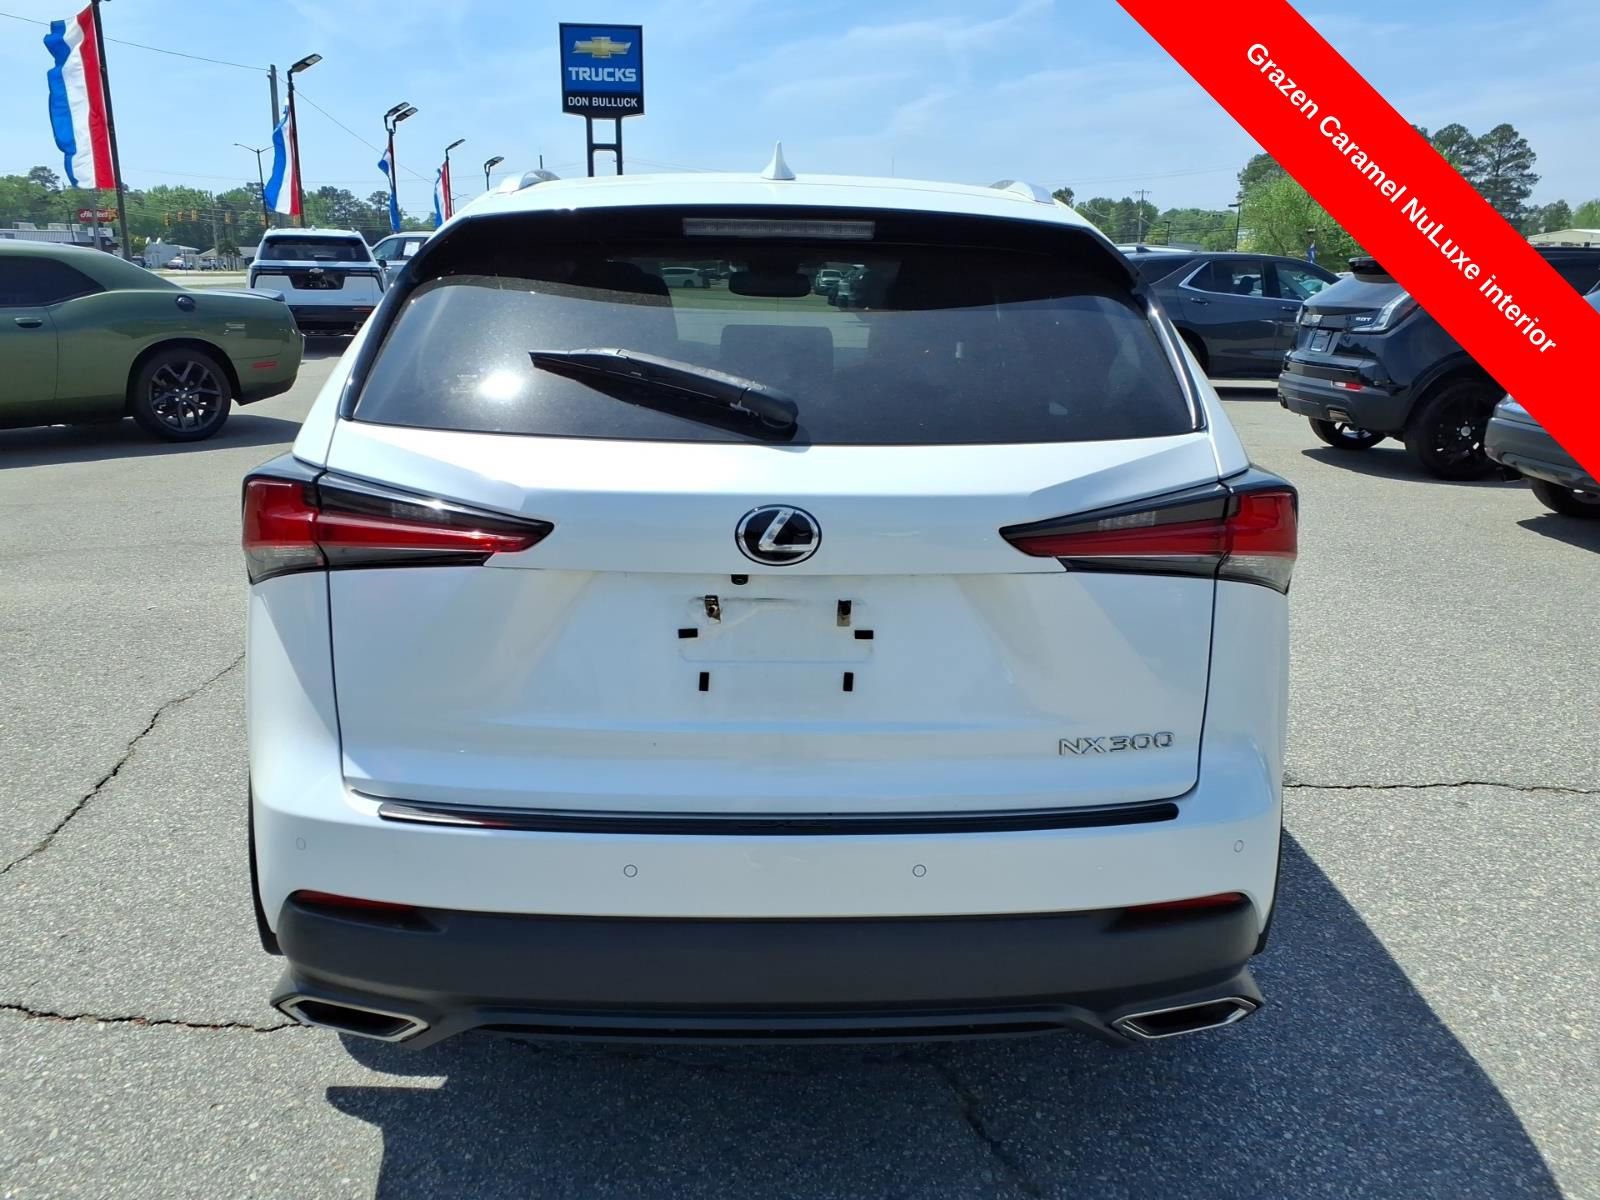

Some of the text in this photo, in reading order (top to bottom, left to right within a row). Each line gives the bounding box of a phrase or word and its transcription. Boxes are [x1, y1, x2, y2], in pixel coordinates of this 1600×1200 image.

[568, 66, 637, 82] TRUCKS
[567, 96, 638, 108] DON BULLUCK
